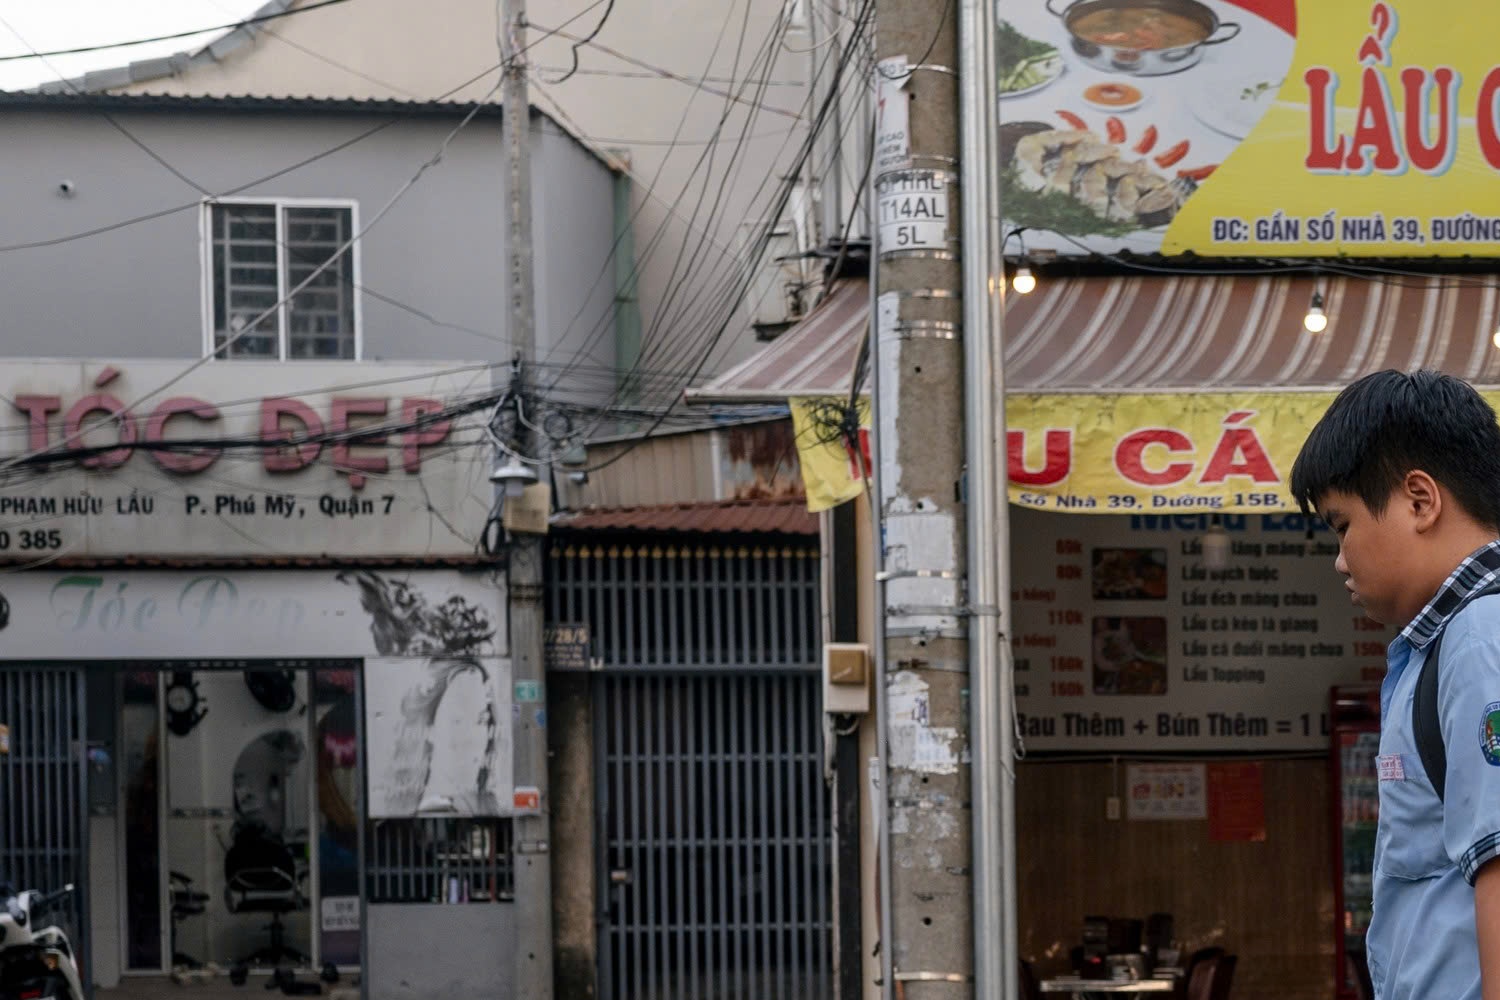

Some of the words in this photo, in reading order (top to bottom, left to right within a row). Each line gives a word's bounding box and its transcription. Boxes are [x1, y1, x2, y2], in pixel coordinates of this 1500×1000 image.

[1304, 2, 1457, 172] LẨU
[880, 197, 945, 222] T14AL
[897, 226, 926, 246] 5L
[1213, 219, 1248, 241] ĐC:
[1307, 211, 1335, 241] SỐ
[1342, 214, 1386, 241] NHÀ
[1393, 219, 1425, 243] 39,
[14, 366, 223, 475] TÓC
[259, 396, 452, 490] ĐẸP
[1116, 410, 1280, 485] CÁ
[184, 494, 207, 515] P.
[215, 494, 255, 515] Phú
[319, 494, 373, 518] Quận
[382, 495, 395, 515] 7
[1056, 494, 1097, 508] Nhà
[1108, 495, 1143, 510] 39,
[1152, 494, 1222, 509] Đường
[1235, 493, 1287, 508] 15B,
[19, 529, 62, 550] 385
[1062, 712, 1125, 738] Thêm
[1157, 711, 1200, 738] Bún
[1206, 712, 1269, 738] Thêm
